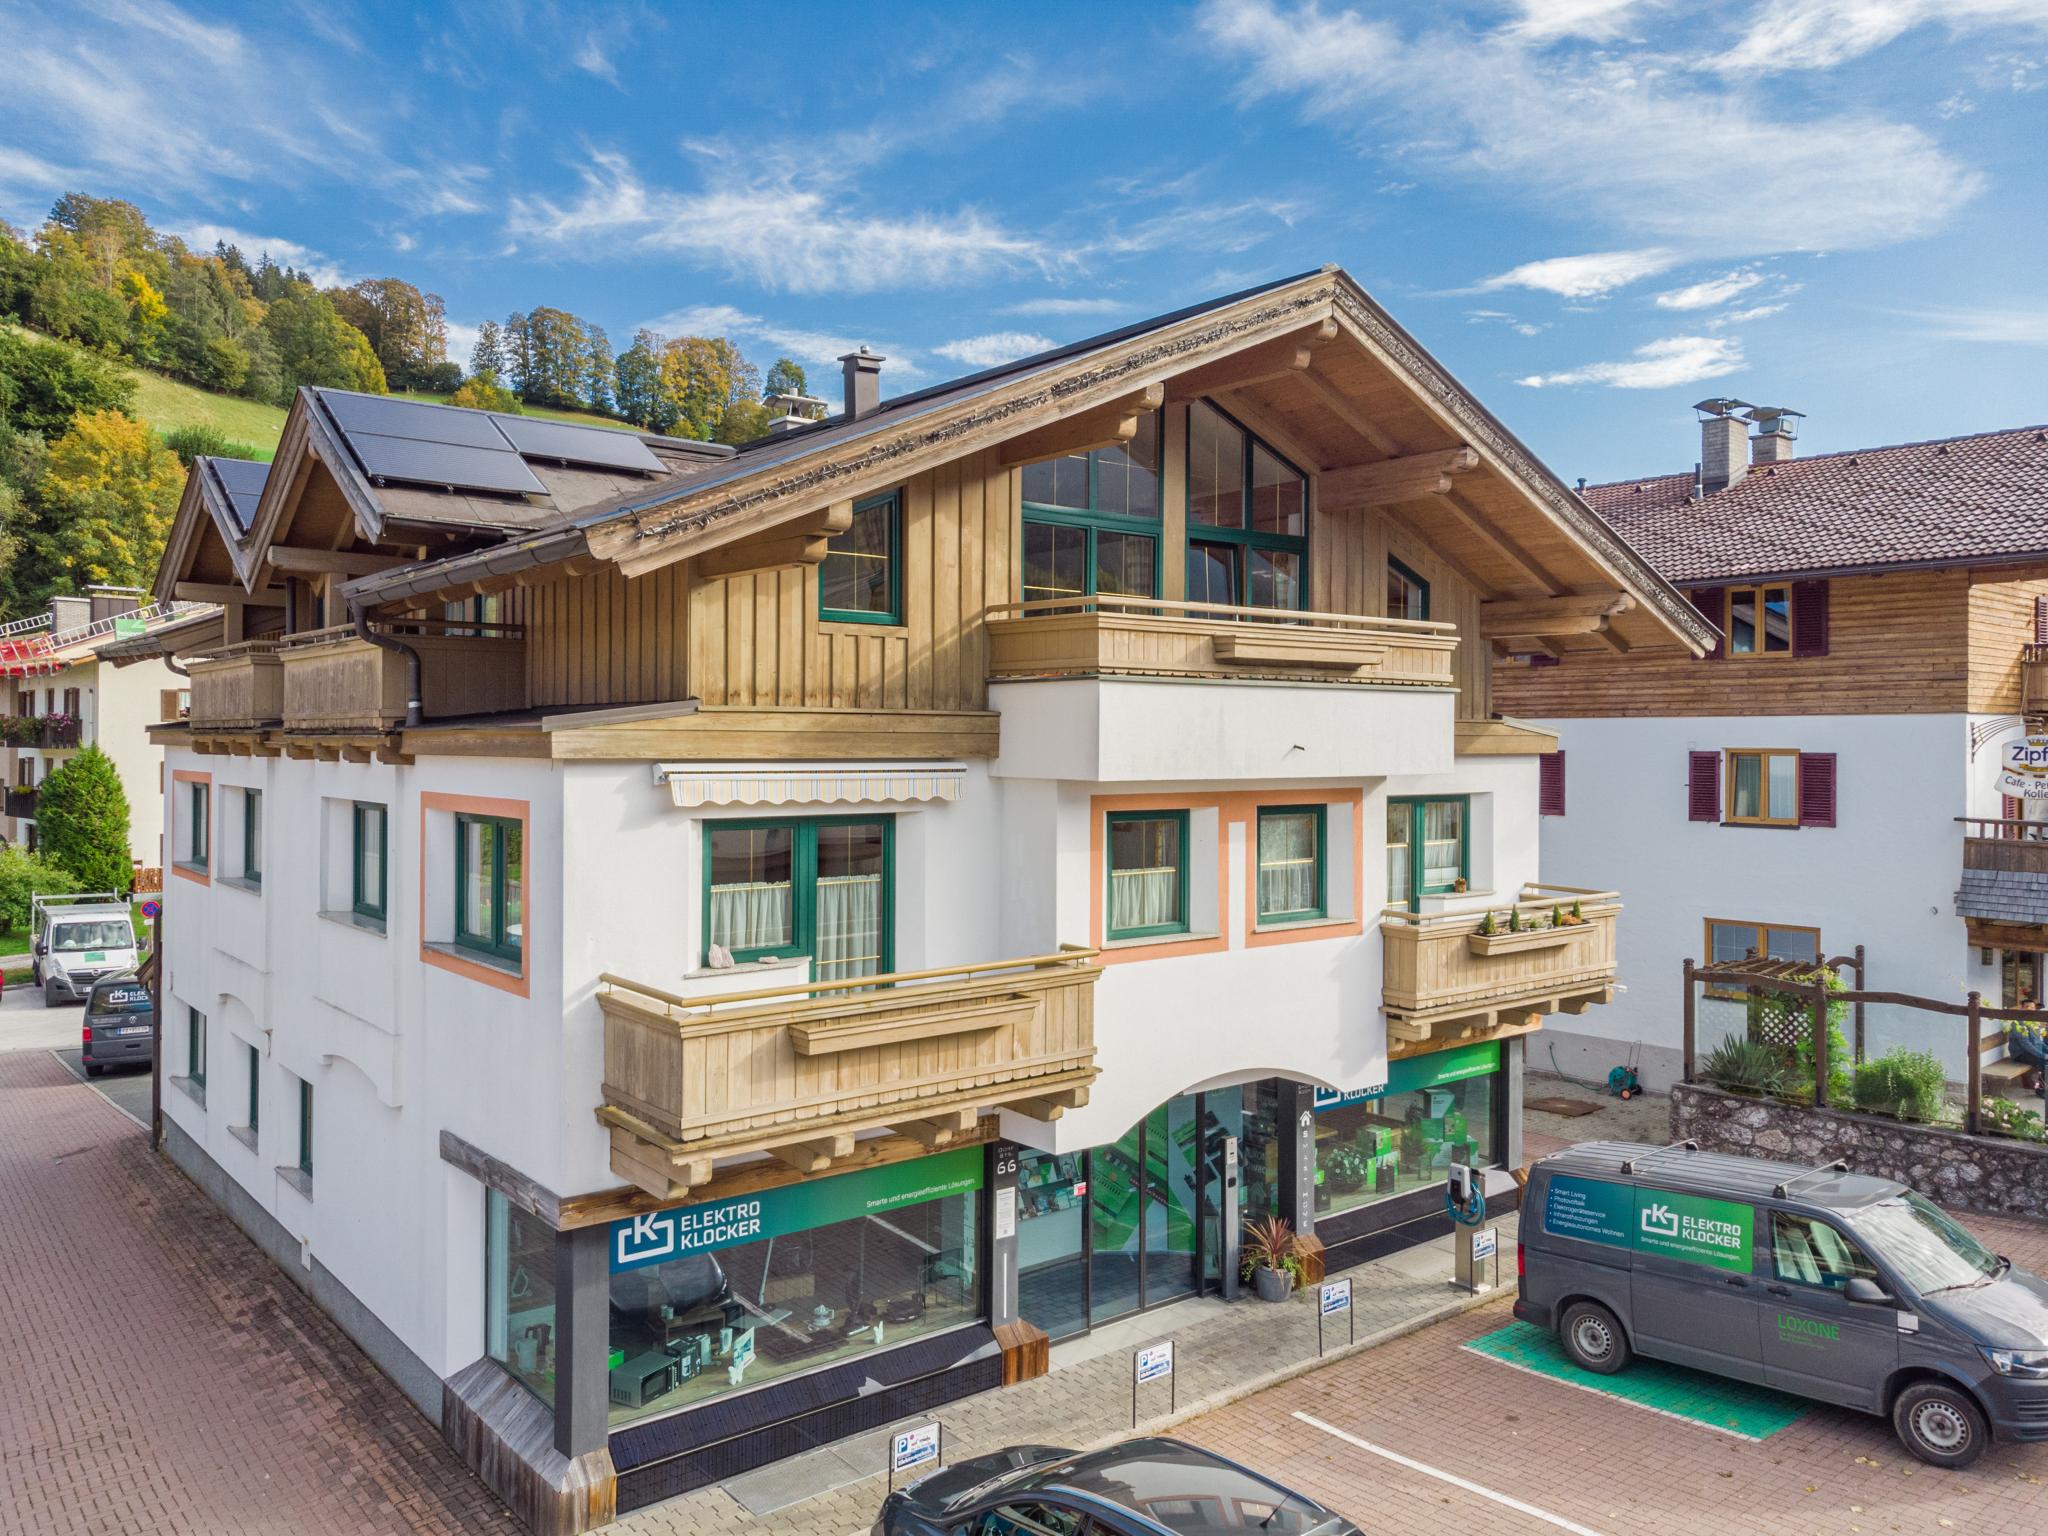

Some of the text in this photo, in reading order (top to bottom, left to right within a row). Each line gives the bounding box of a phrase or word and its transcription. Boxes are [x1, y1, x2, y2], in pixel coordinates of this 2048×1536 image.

[2005, 776, 2026, 788] Cafe
[997, 1159, 1017, 1175] 66
[1554, 1188, 1586, 1200] Smart Living
[681, 1200, 760, 1232] ELEKTRO
[1682, 1215, 1741, 1237] ELEKTRO
[681, 1219, 761, 1250] KLOCKER
[1682, 1228, 1741, 1249] KLOCKER
[1777, 1313, 1840, 1341] LOXONE
